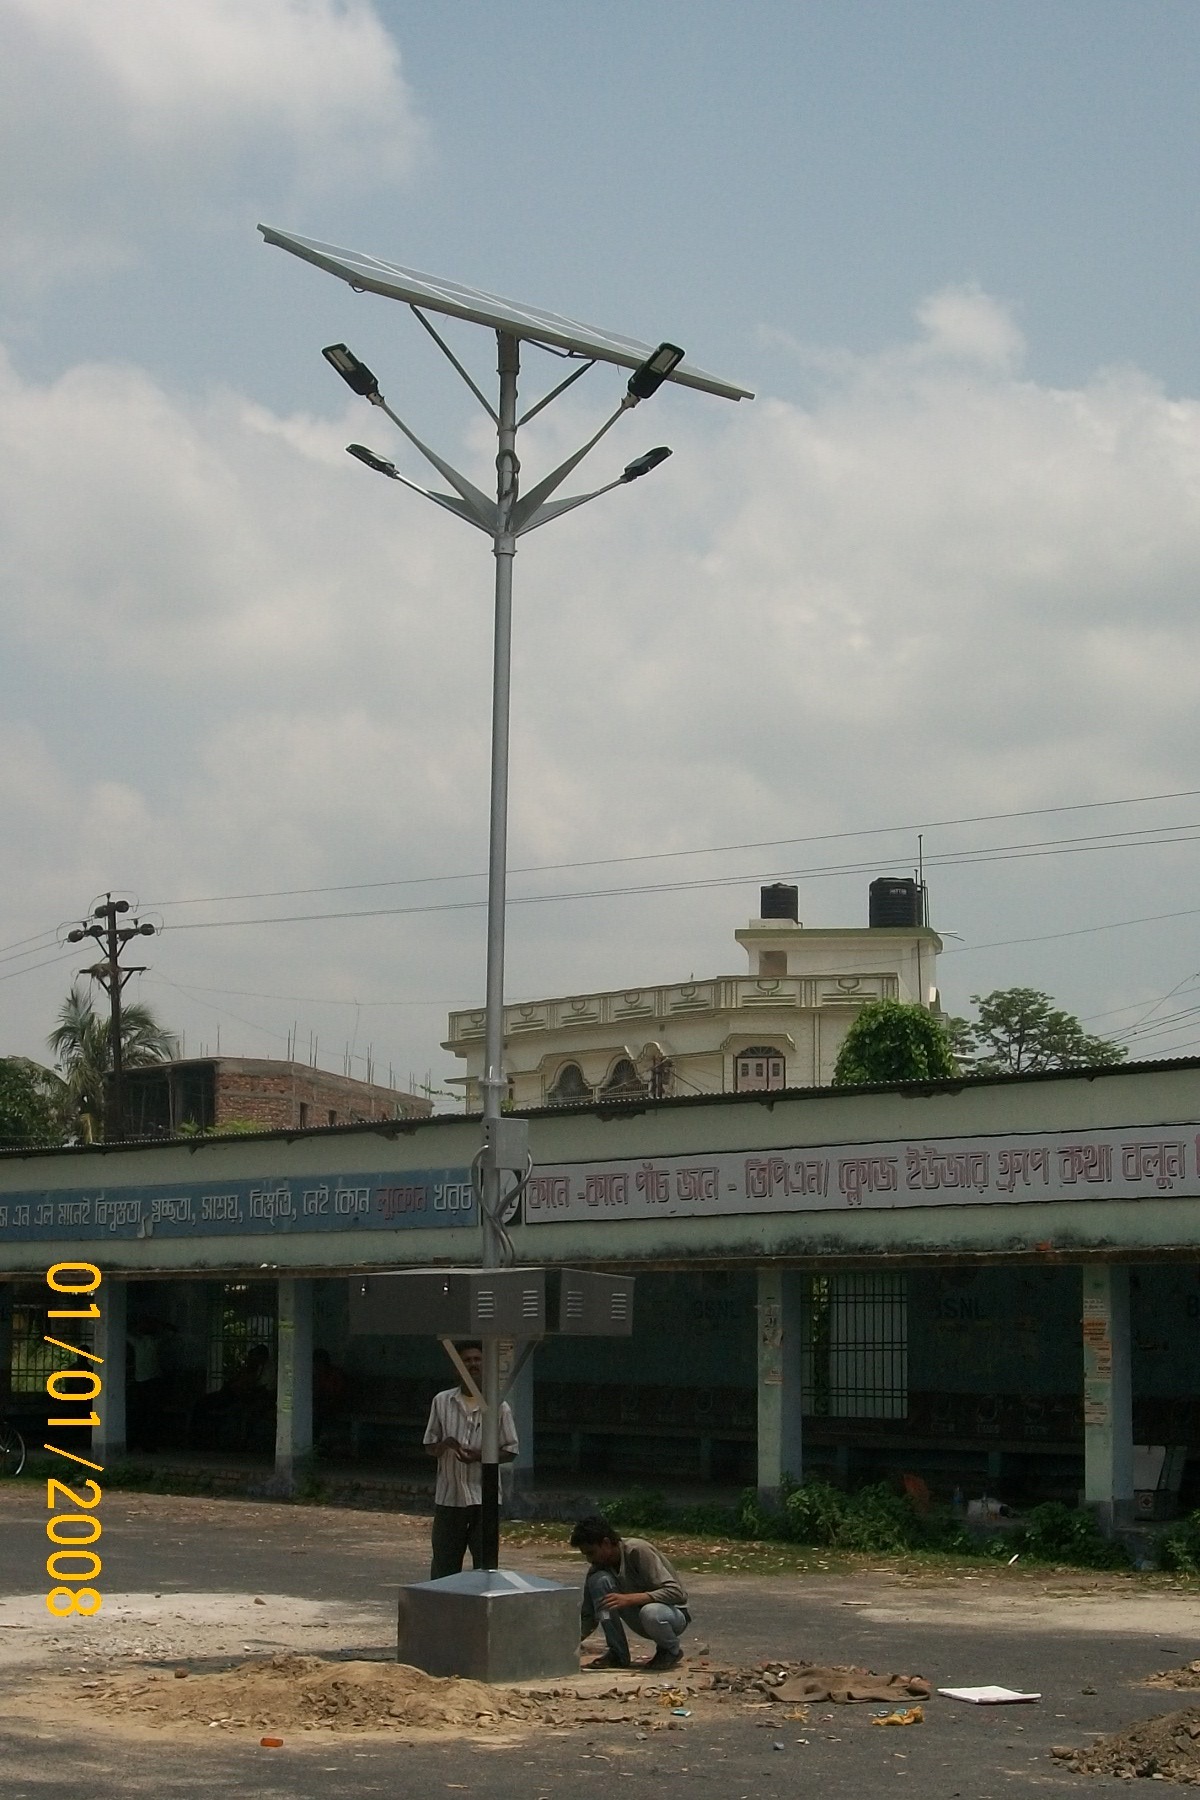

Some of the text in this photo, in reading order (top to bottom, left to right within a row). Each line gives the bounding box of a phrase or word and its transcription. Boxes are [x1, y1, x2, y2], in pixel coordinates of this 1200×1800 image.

[528, 1176, 570, 1209] কানে
[635, 1162, 670, 1204] পাঁচ
[675, 1167, 720, 1201] জনে
[837, 1156, 898, 1207] ক্লোজ
[905, 1145, 991, 1195] ইউজার
[995, 1147, 1050, 1193] গ্রুপে
[1057, 1144, 1113, 1185] কথা
[1120, 1140, 1187, 1190] বলুন
[13, 1204, 30, 1227] এন
[34, 1203, 54, 1226] এল
[58, 1196, 91, 1226] মানেই
[201, 1195, 243, 1224] সাশ্রয়,
[249, 1188, 297, 1227] বিস্তৃতি,
[302, 1182, 330, 1215] নেই
[335, 1187, 371, 1216] কোন
[376, 1185, 429, 1221] লুকোন
[433, 1183, 473, 1216] খরচ
